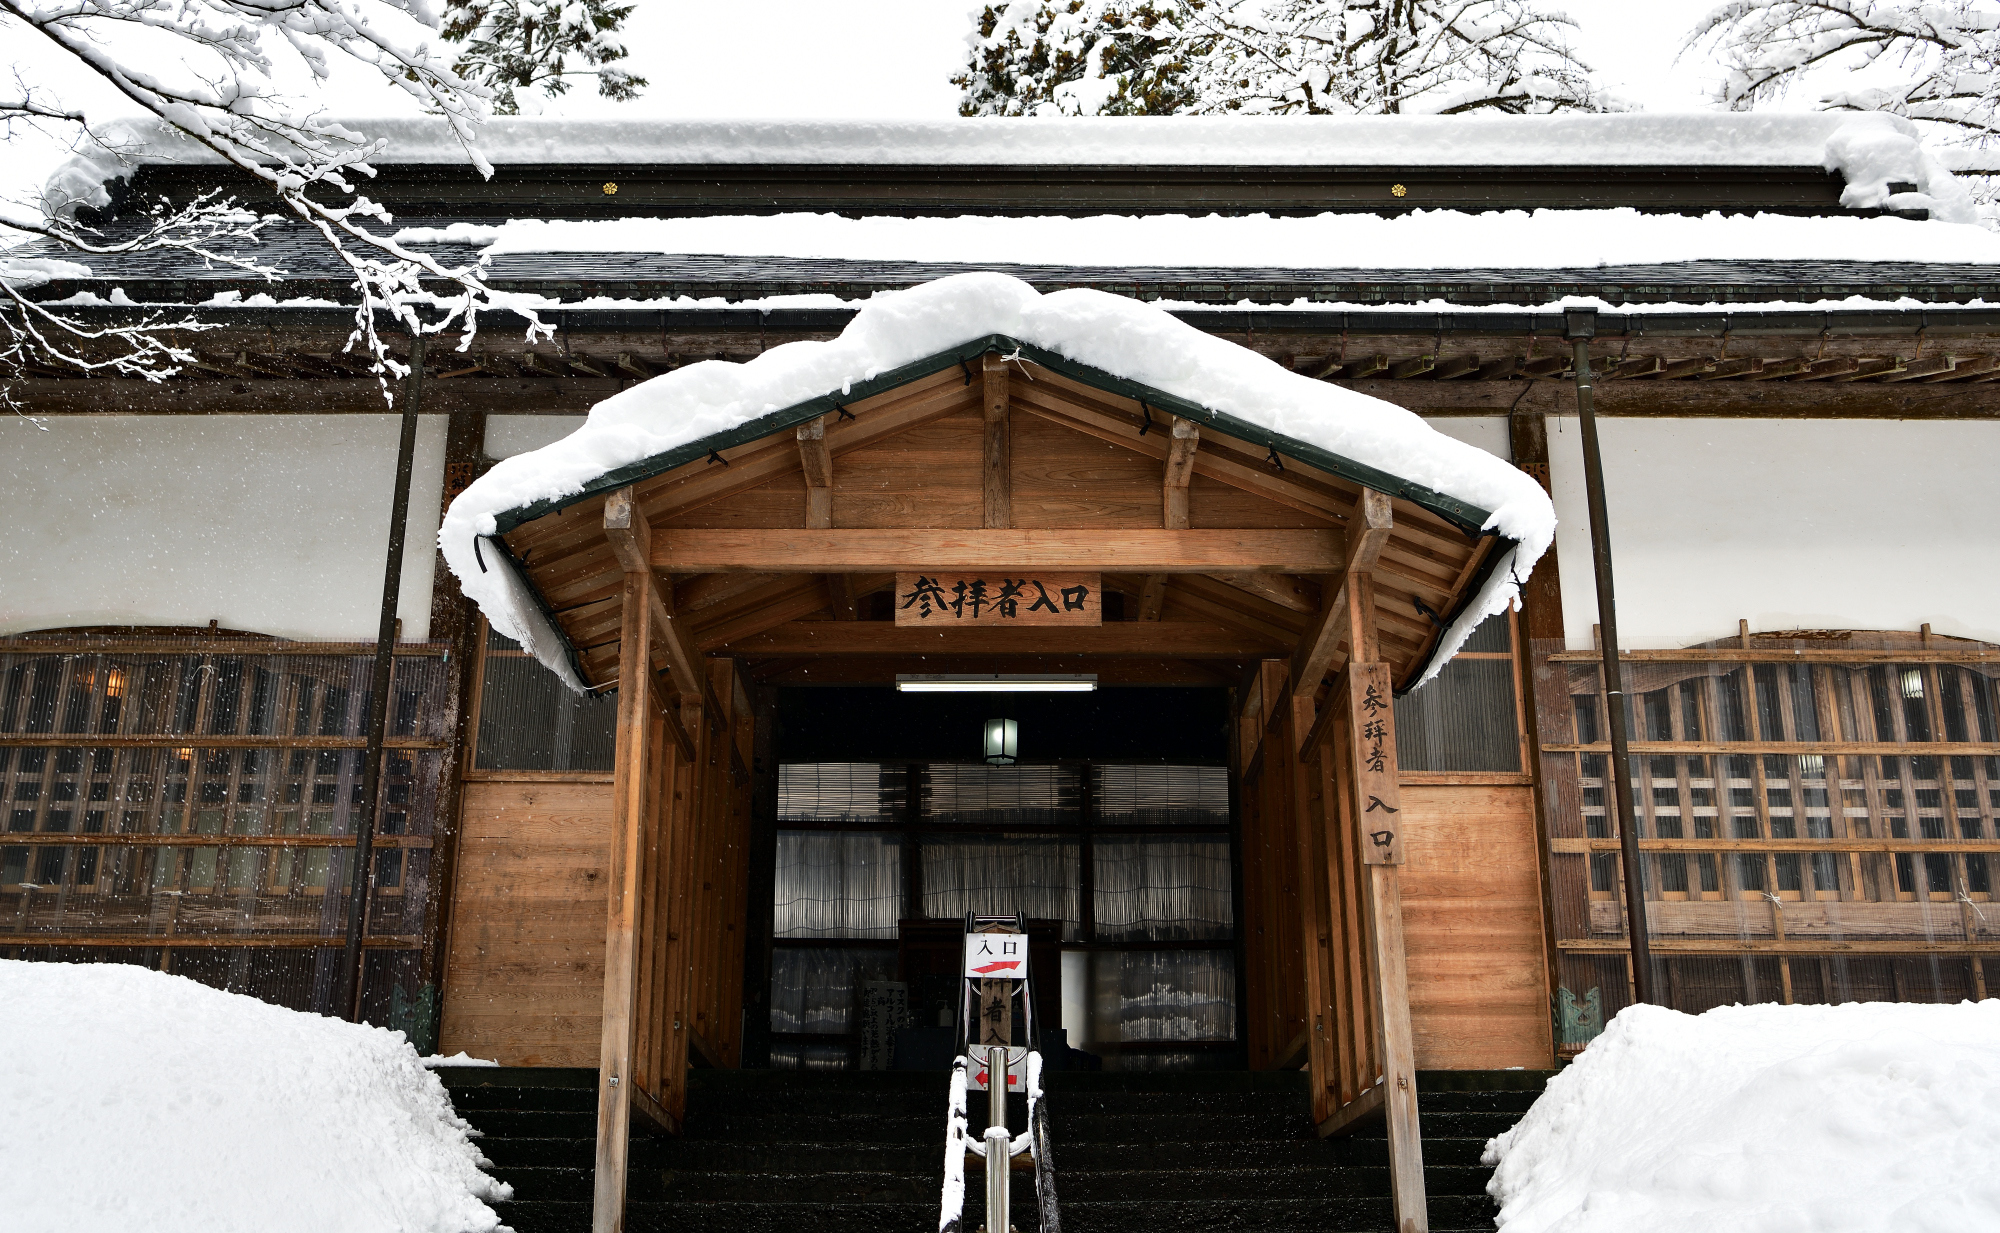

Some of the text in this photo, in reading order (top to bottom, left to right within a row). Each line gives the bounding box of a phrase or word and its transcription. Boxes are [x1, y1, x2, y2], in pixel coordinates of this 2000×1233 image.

[902, 575, 1089, 618] 参拝者入口
[977, 939, 1017, 955] 入口
